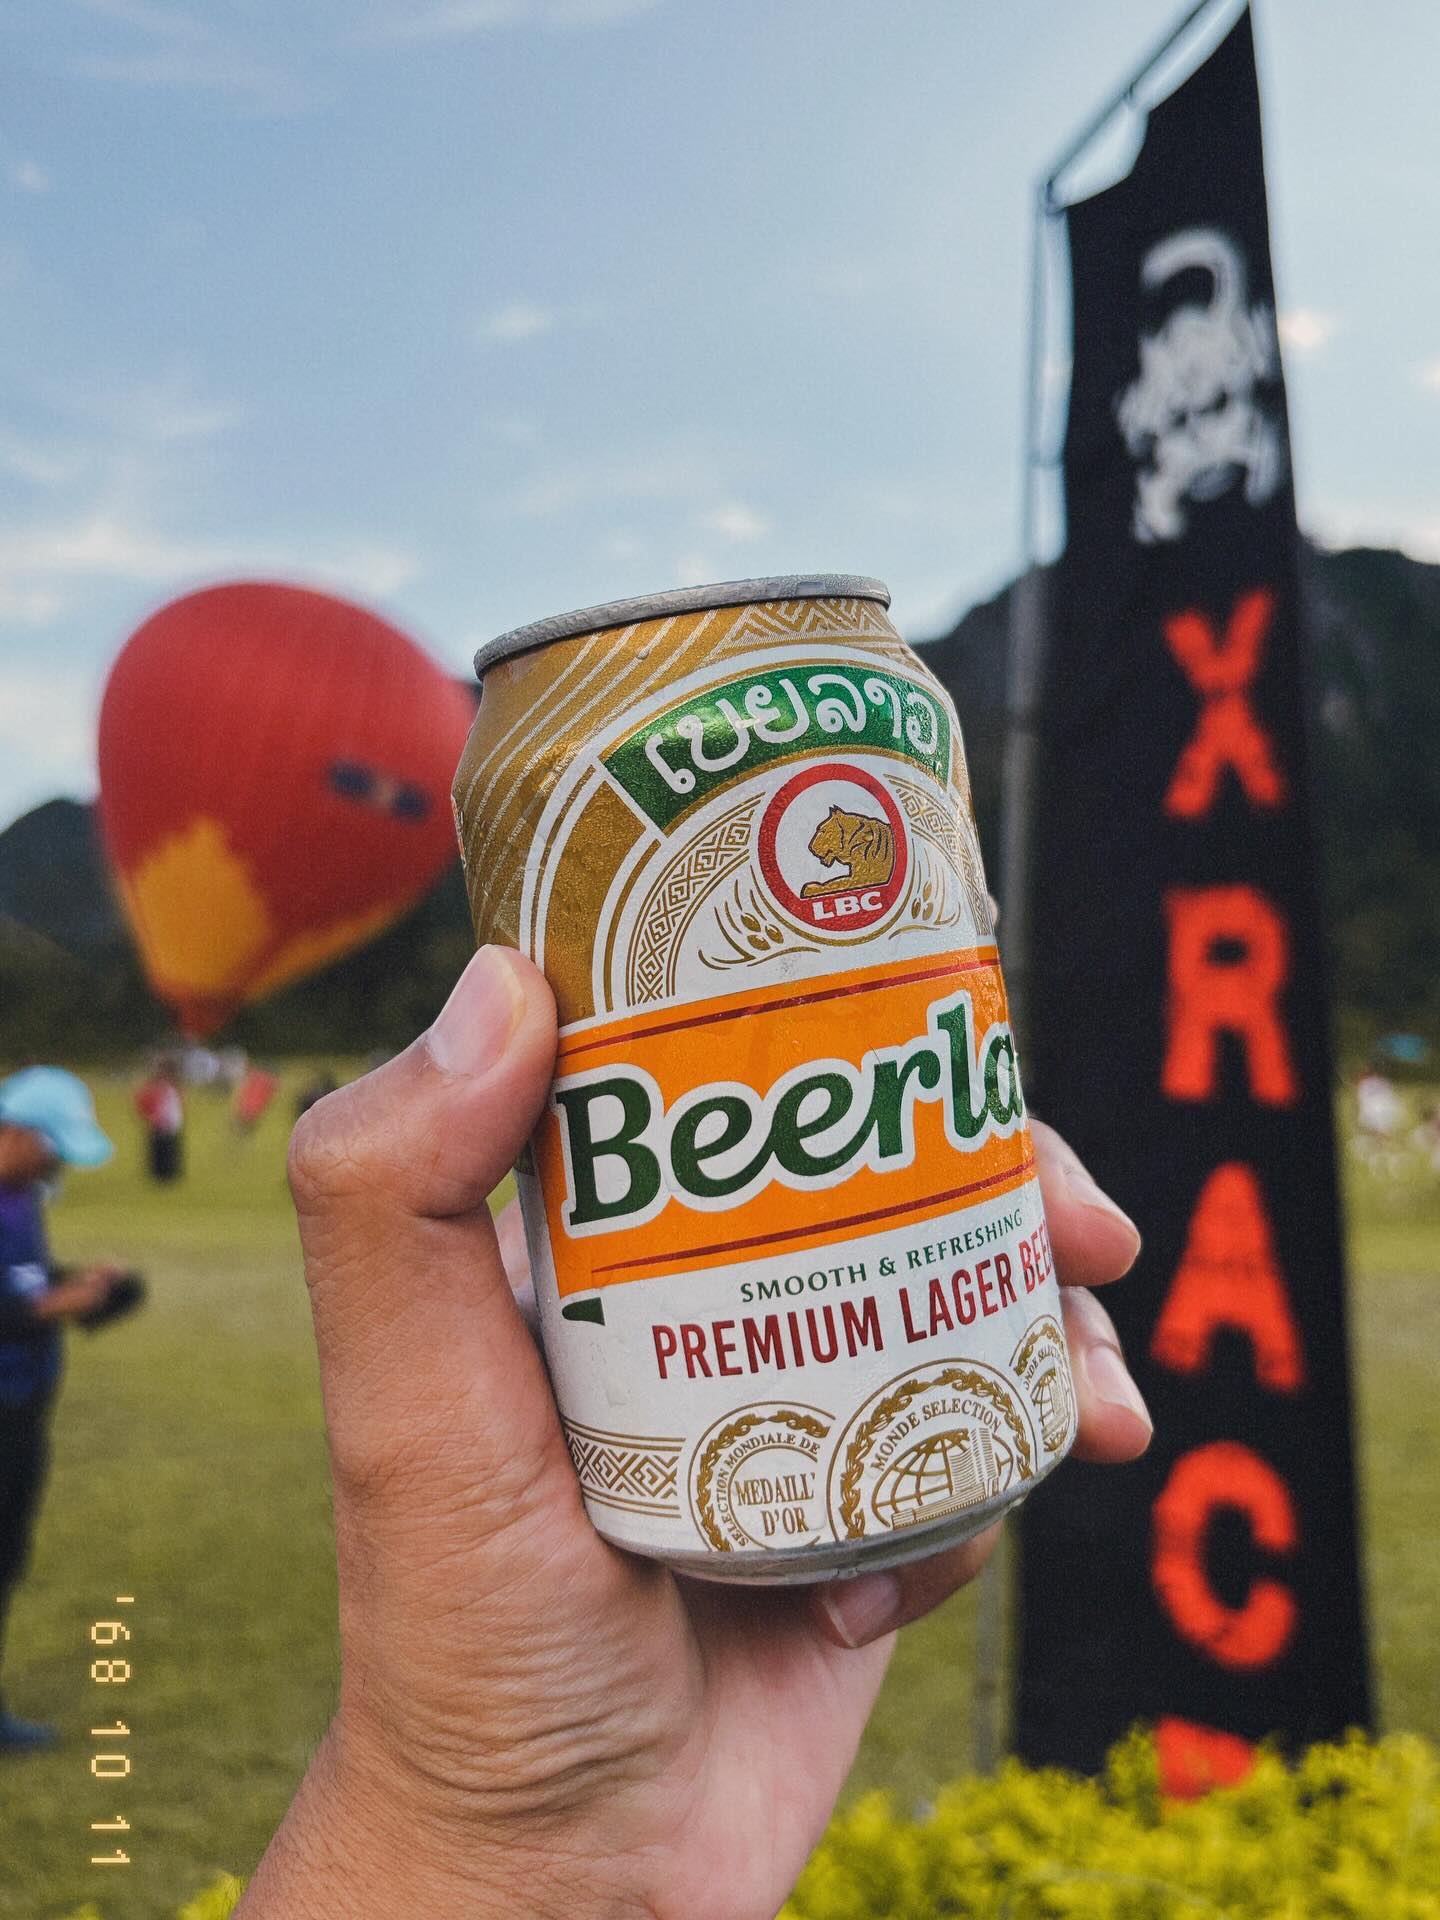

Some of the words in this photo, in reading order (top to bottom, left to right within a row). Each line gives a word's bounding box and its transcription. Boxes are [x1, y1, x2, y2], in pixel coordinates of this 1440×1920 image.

[812, 891, 883, 920] LBC
[740, 1263, 867, 1303] SMOOTH
[878, 1256, 896, 1278] &
[906, 1208, 1023, 1269] REFRESHING
[652, 1296, 884, 1380] PREMIUM
[899, 1252, 1017, 1344] LAGER
[724, 1432, 796, 1469] MONDIALE
[800, 1436, 821, 1455] DE
[870, 1412, 921, 1472] MONDE
[922, 1398, 1002, 1433] SELECTION
[734, 1471, 816, 1506] MEDAILL
[716, 1468, 749, 1547] SELECTION
[760, 1507, 809, 1537] D'OR
